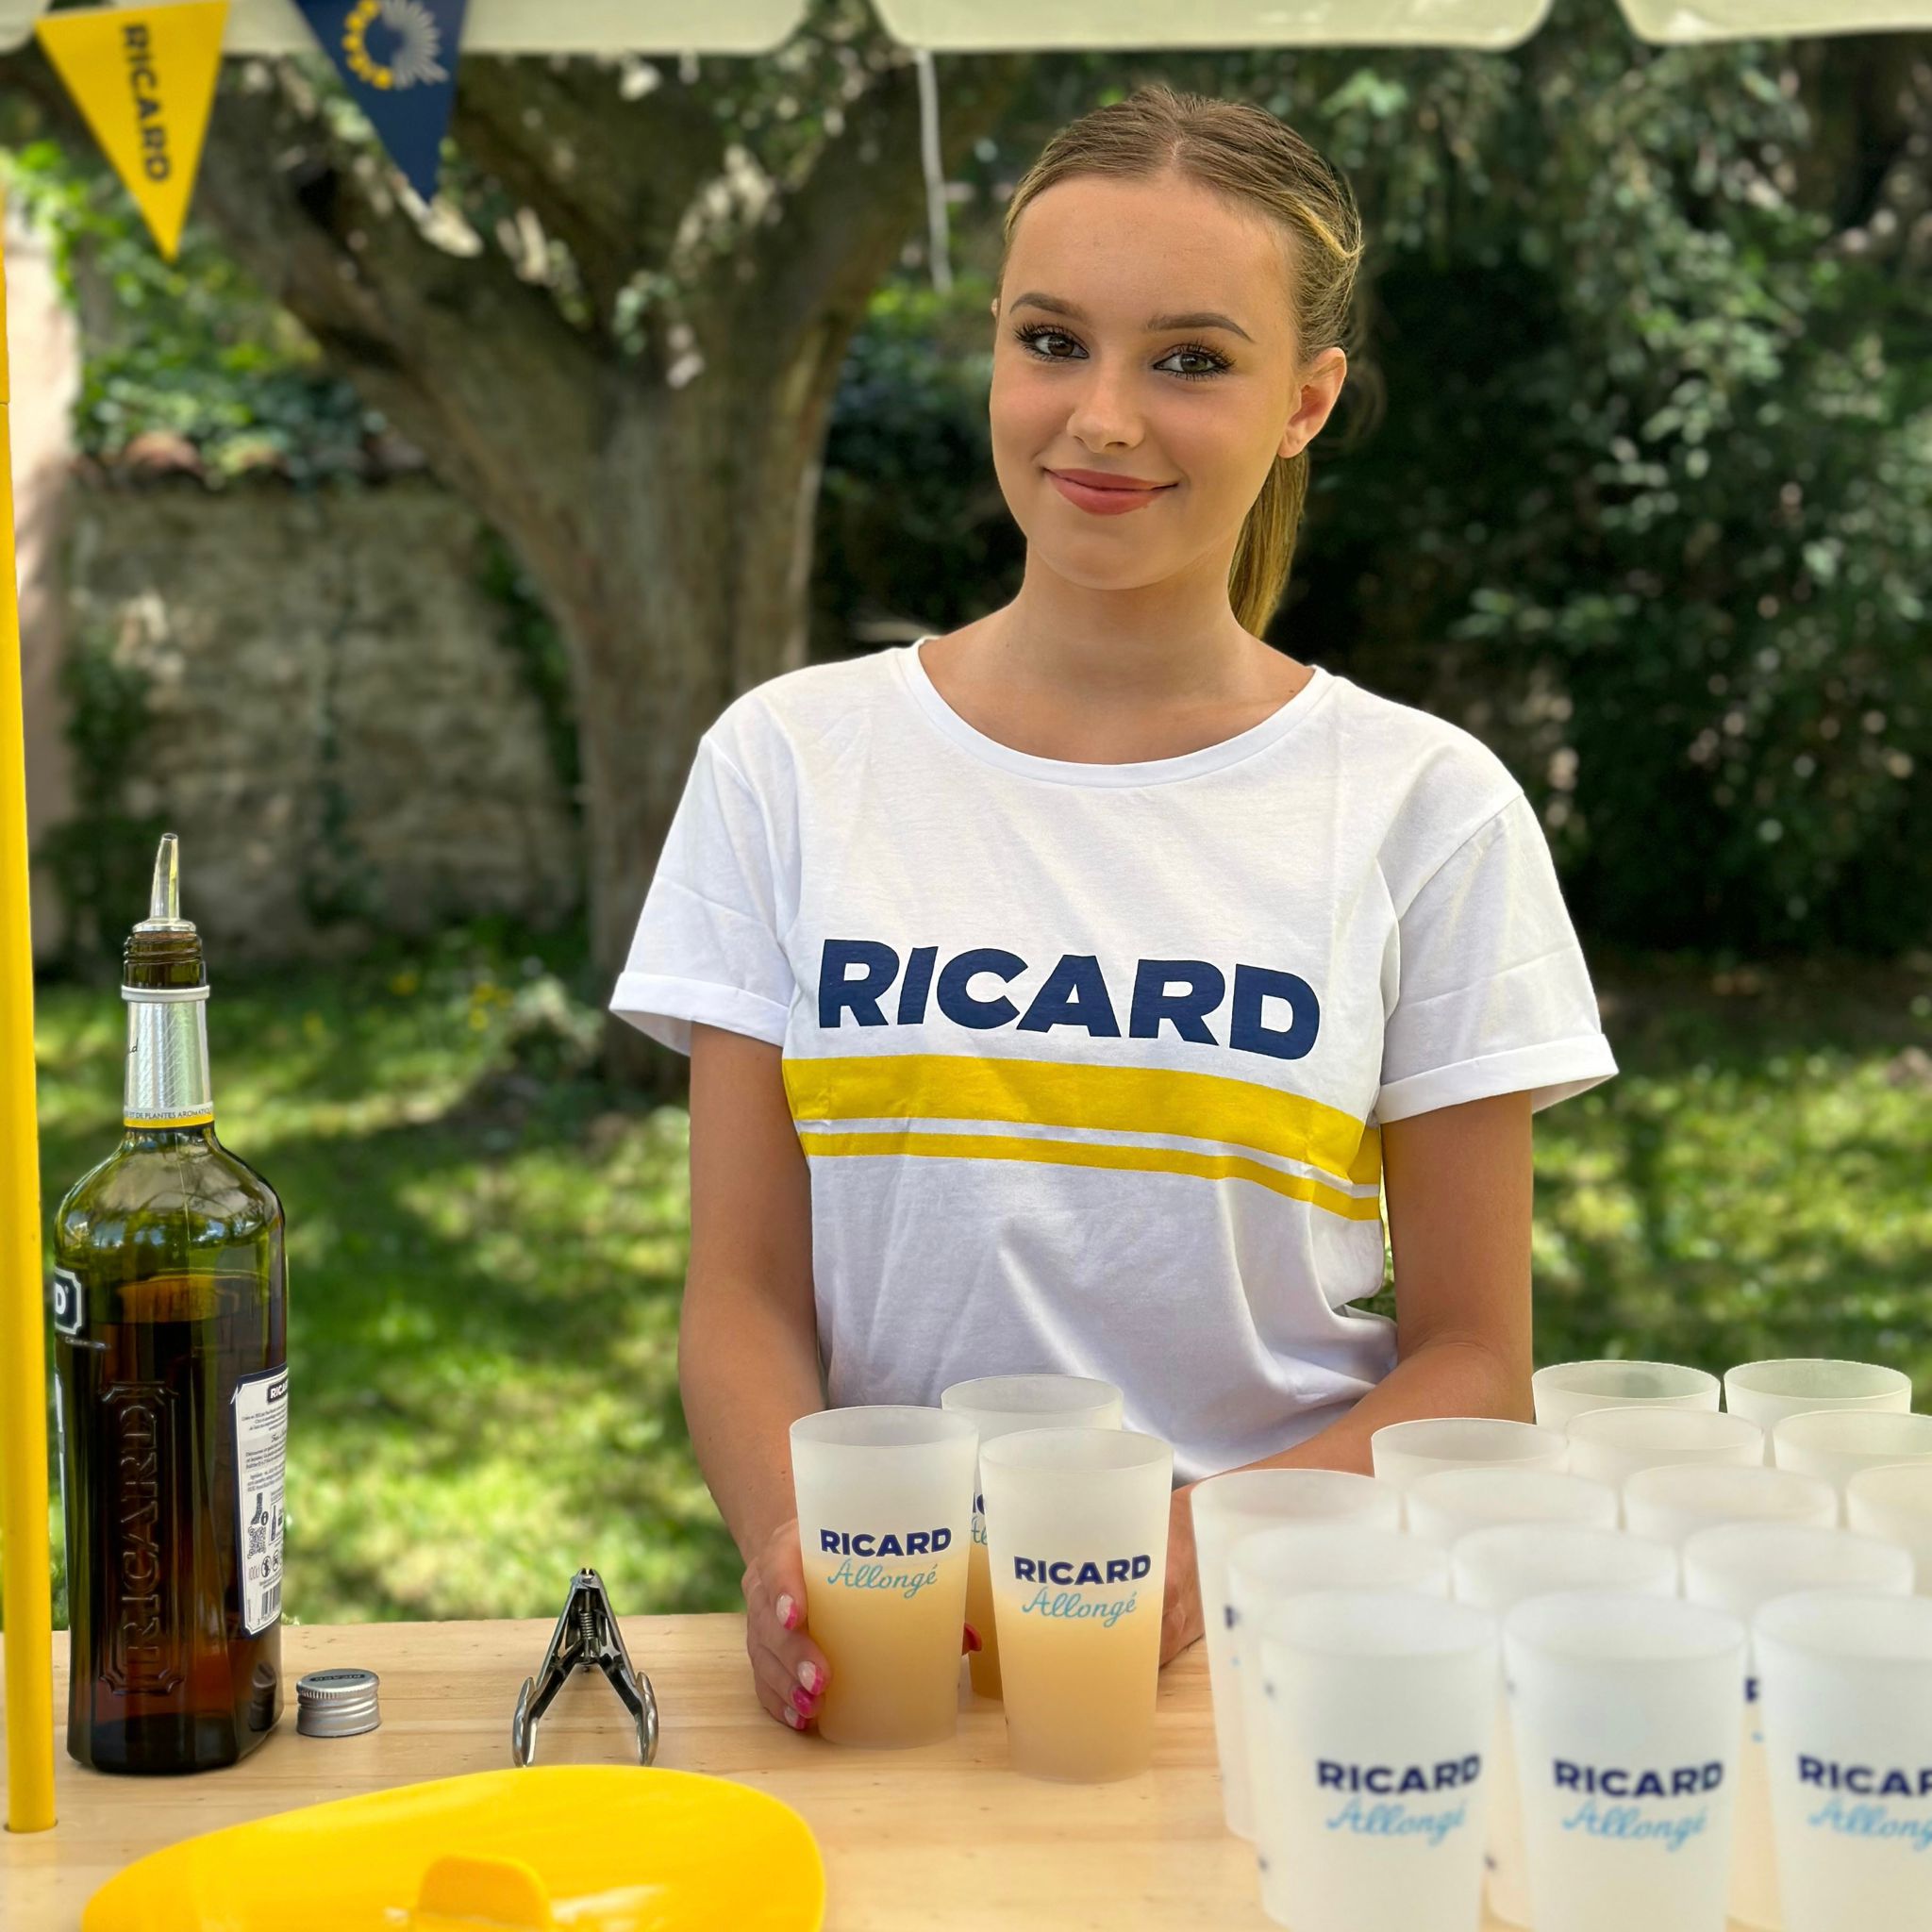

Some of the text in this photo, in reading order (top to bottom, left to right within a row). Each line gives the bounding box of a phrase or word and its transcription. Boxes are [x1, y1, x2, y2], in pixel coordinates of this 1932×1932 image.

[125, 25, 170, 180] RICARD
[818, 939, 1321, 1060] RICARD
[120, 1405, 159, 1666] RICARD
[820, 1527, 952, 1557] RICARD
[826, 1558, 939, 1599] Allongé
[1014, 1555, 1151, 1586] RICARD
[1022, 1586, 1138, 1628] Allongé
[1317, 1754, 1482, 1796] RICARD
[1554, 1758, 1724, 1798] RICARD
